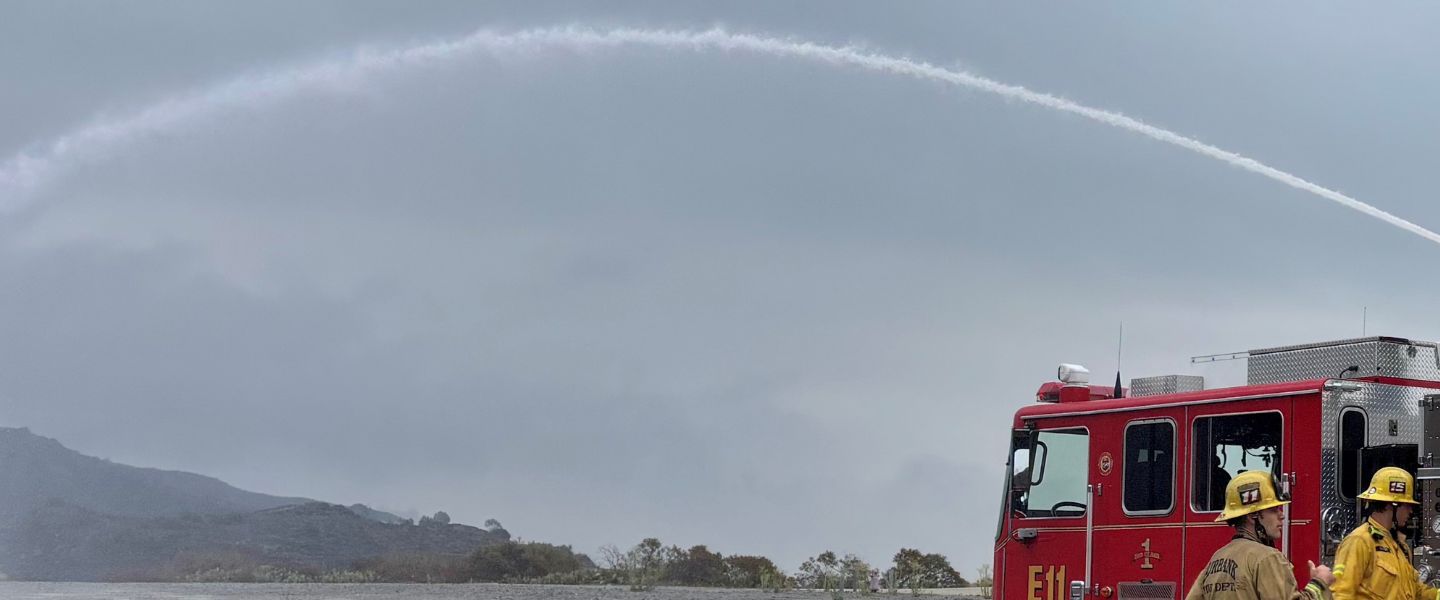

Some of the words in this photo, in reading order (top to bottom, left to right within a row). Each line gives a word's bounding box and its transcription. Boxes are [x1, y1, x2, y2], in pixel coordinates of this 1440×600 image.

[1241, 489, 1259, 504] 11
[1390, 481, 1405, 492] 15
[1140, 538, 1153, 569] 1
[1027, 565, 1065, 600] E11
